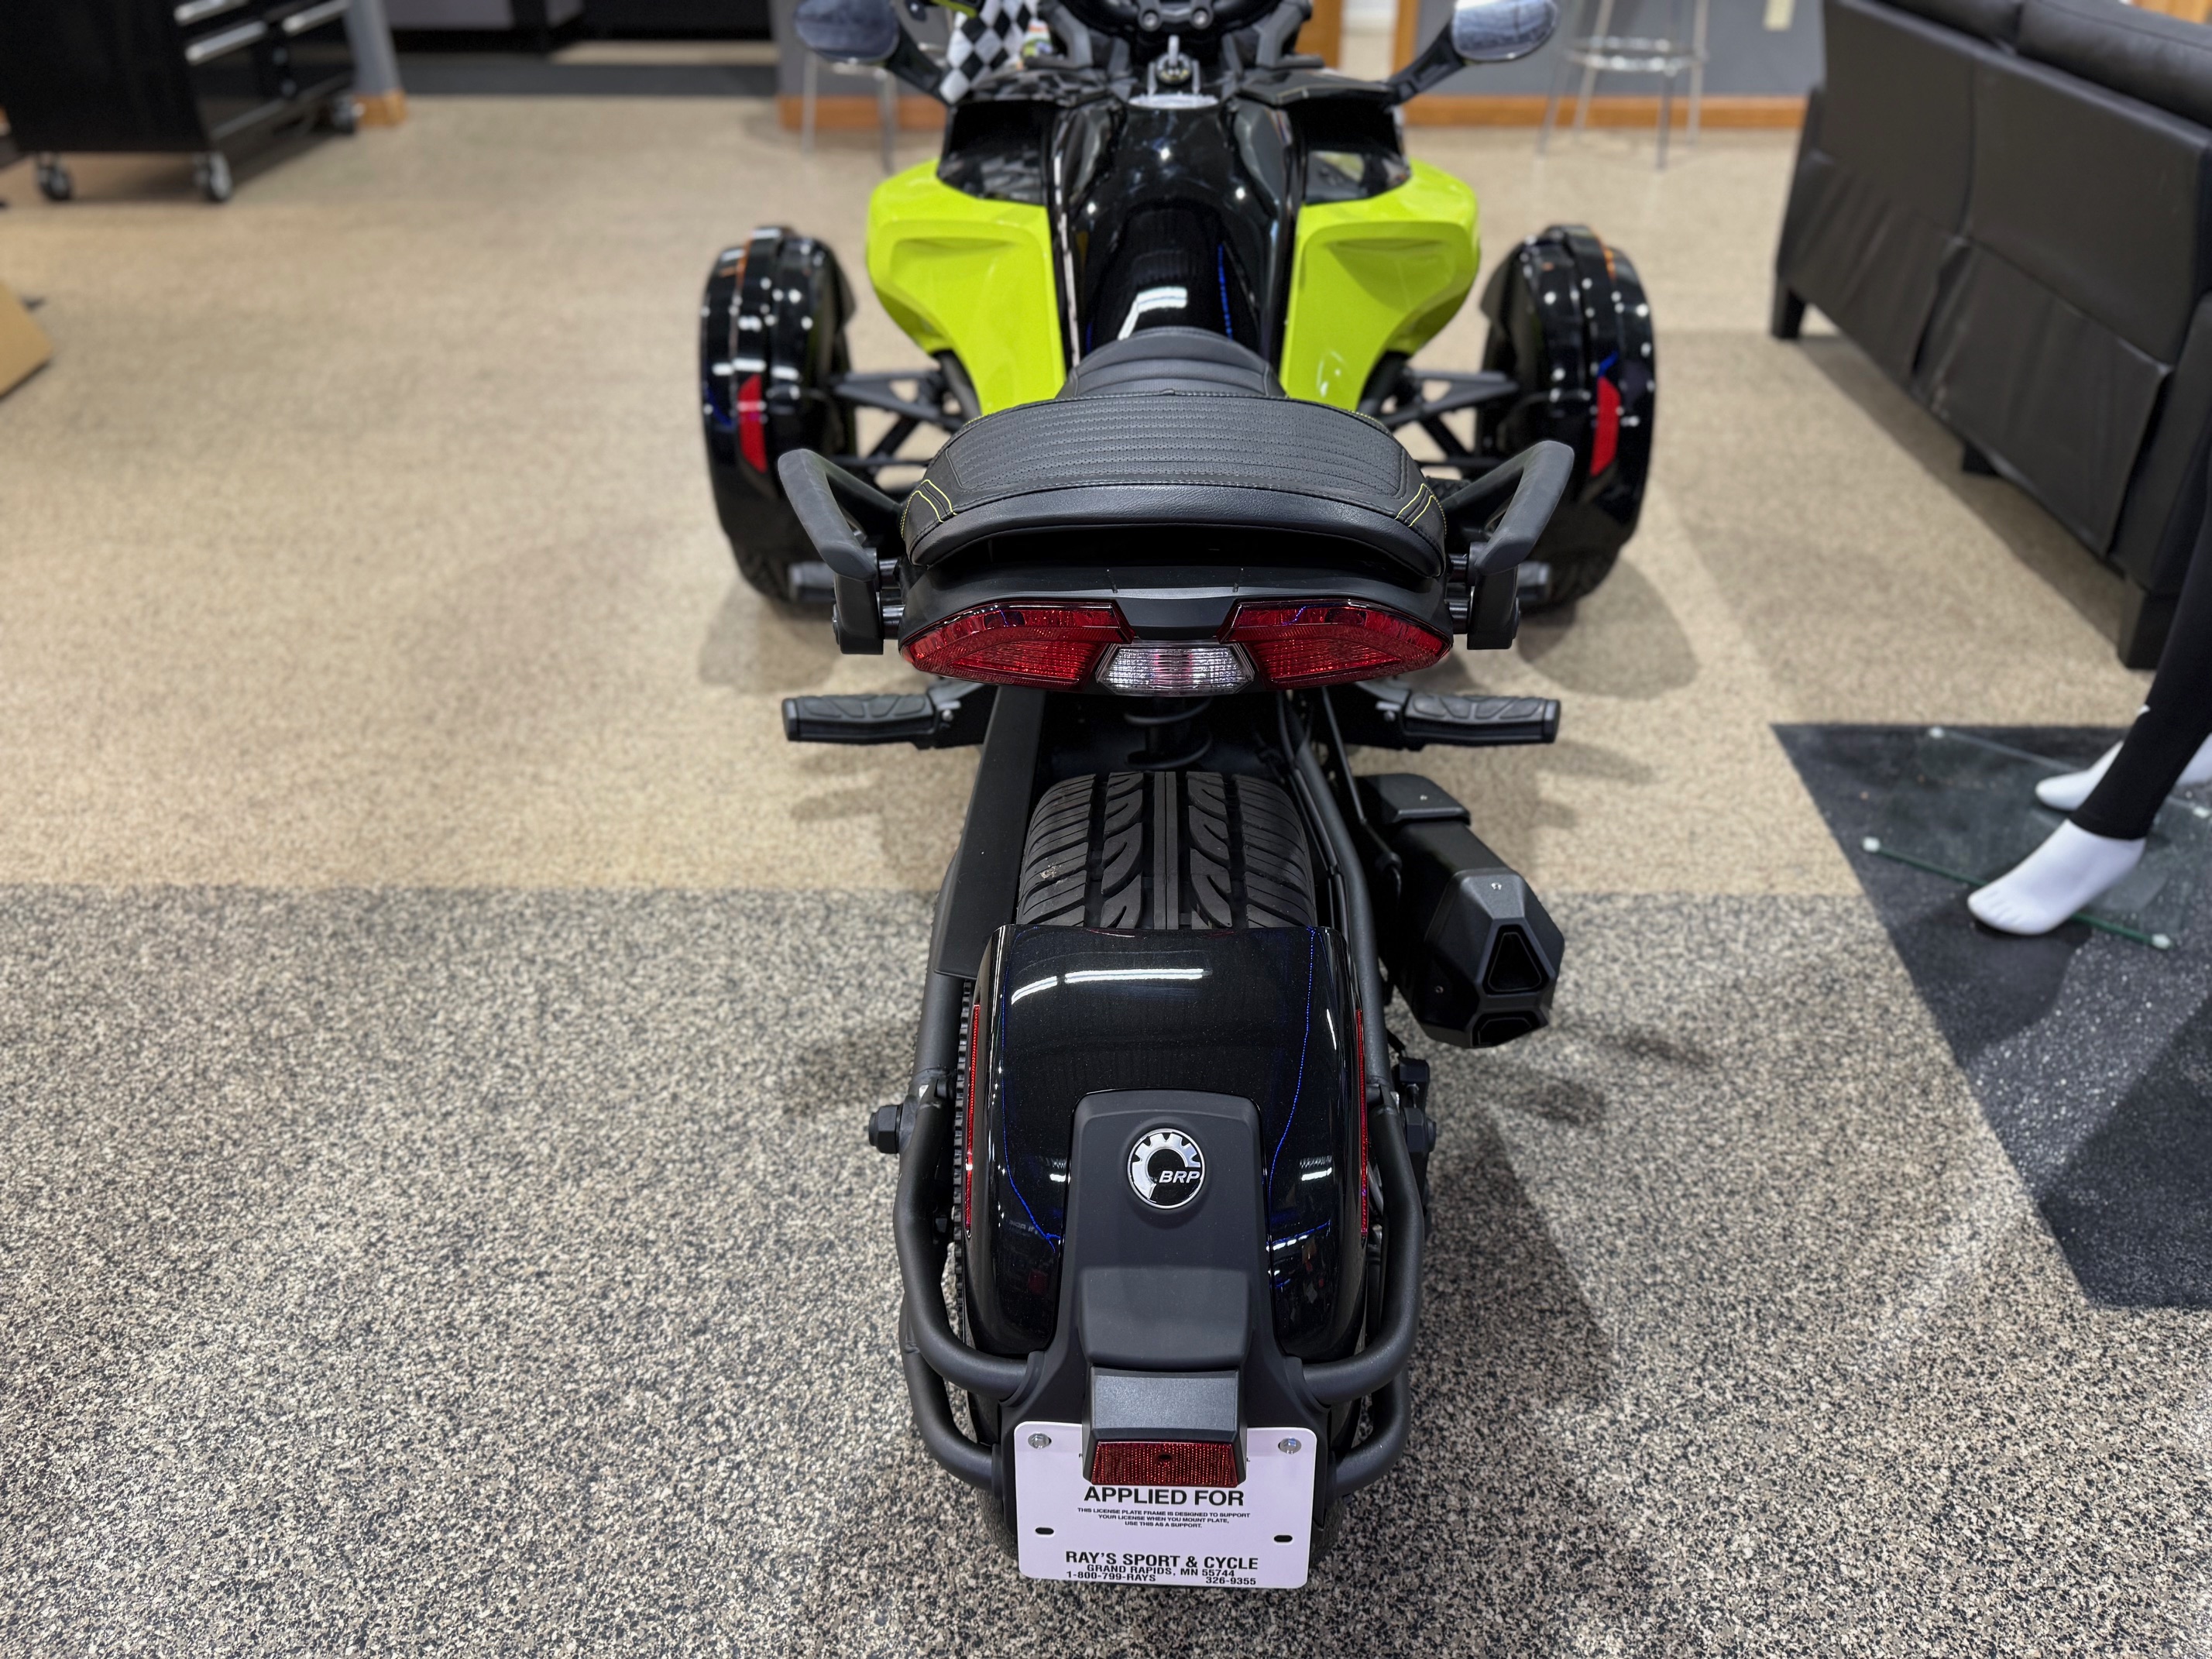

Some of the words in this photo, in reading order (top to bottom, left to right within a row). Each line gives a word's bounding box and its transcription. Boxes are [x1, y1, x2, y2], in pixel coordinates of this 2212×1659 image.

[1159, 1170, 1200, 1183] BRP
[1084, 1486, 1187, 1505] APPLIED
[1194, 1489, 1245, 1506] FOR
[1066, 1551, 1117, 1565] RAY'S
[1122, 1553, 1180, 1567] SPORT
[1185, 1555, 1198, 1568] &
[1204, 1556, 1259, 1570] CYCLE
[1087, 1564, 1126, 1573] GRAND
[1130, 1566, 1176, 1576] RAPIDS,
[1180, 1568, 1198, 1576] MN
[1202, 1568, 1235, 1577] 55744
[1066, 1571, 1156, 1582] 1-800-799-RAYS
[1205, 1576, 1256, 1585] 326-9355
